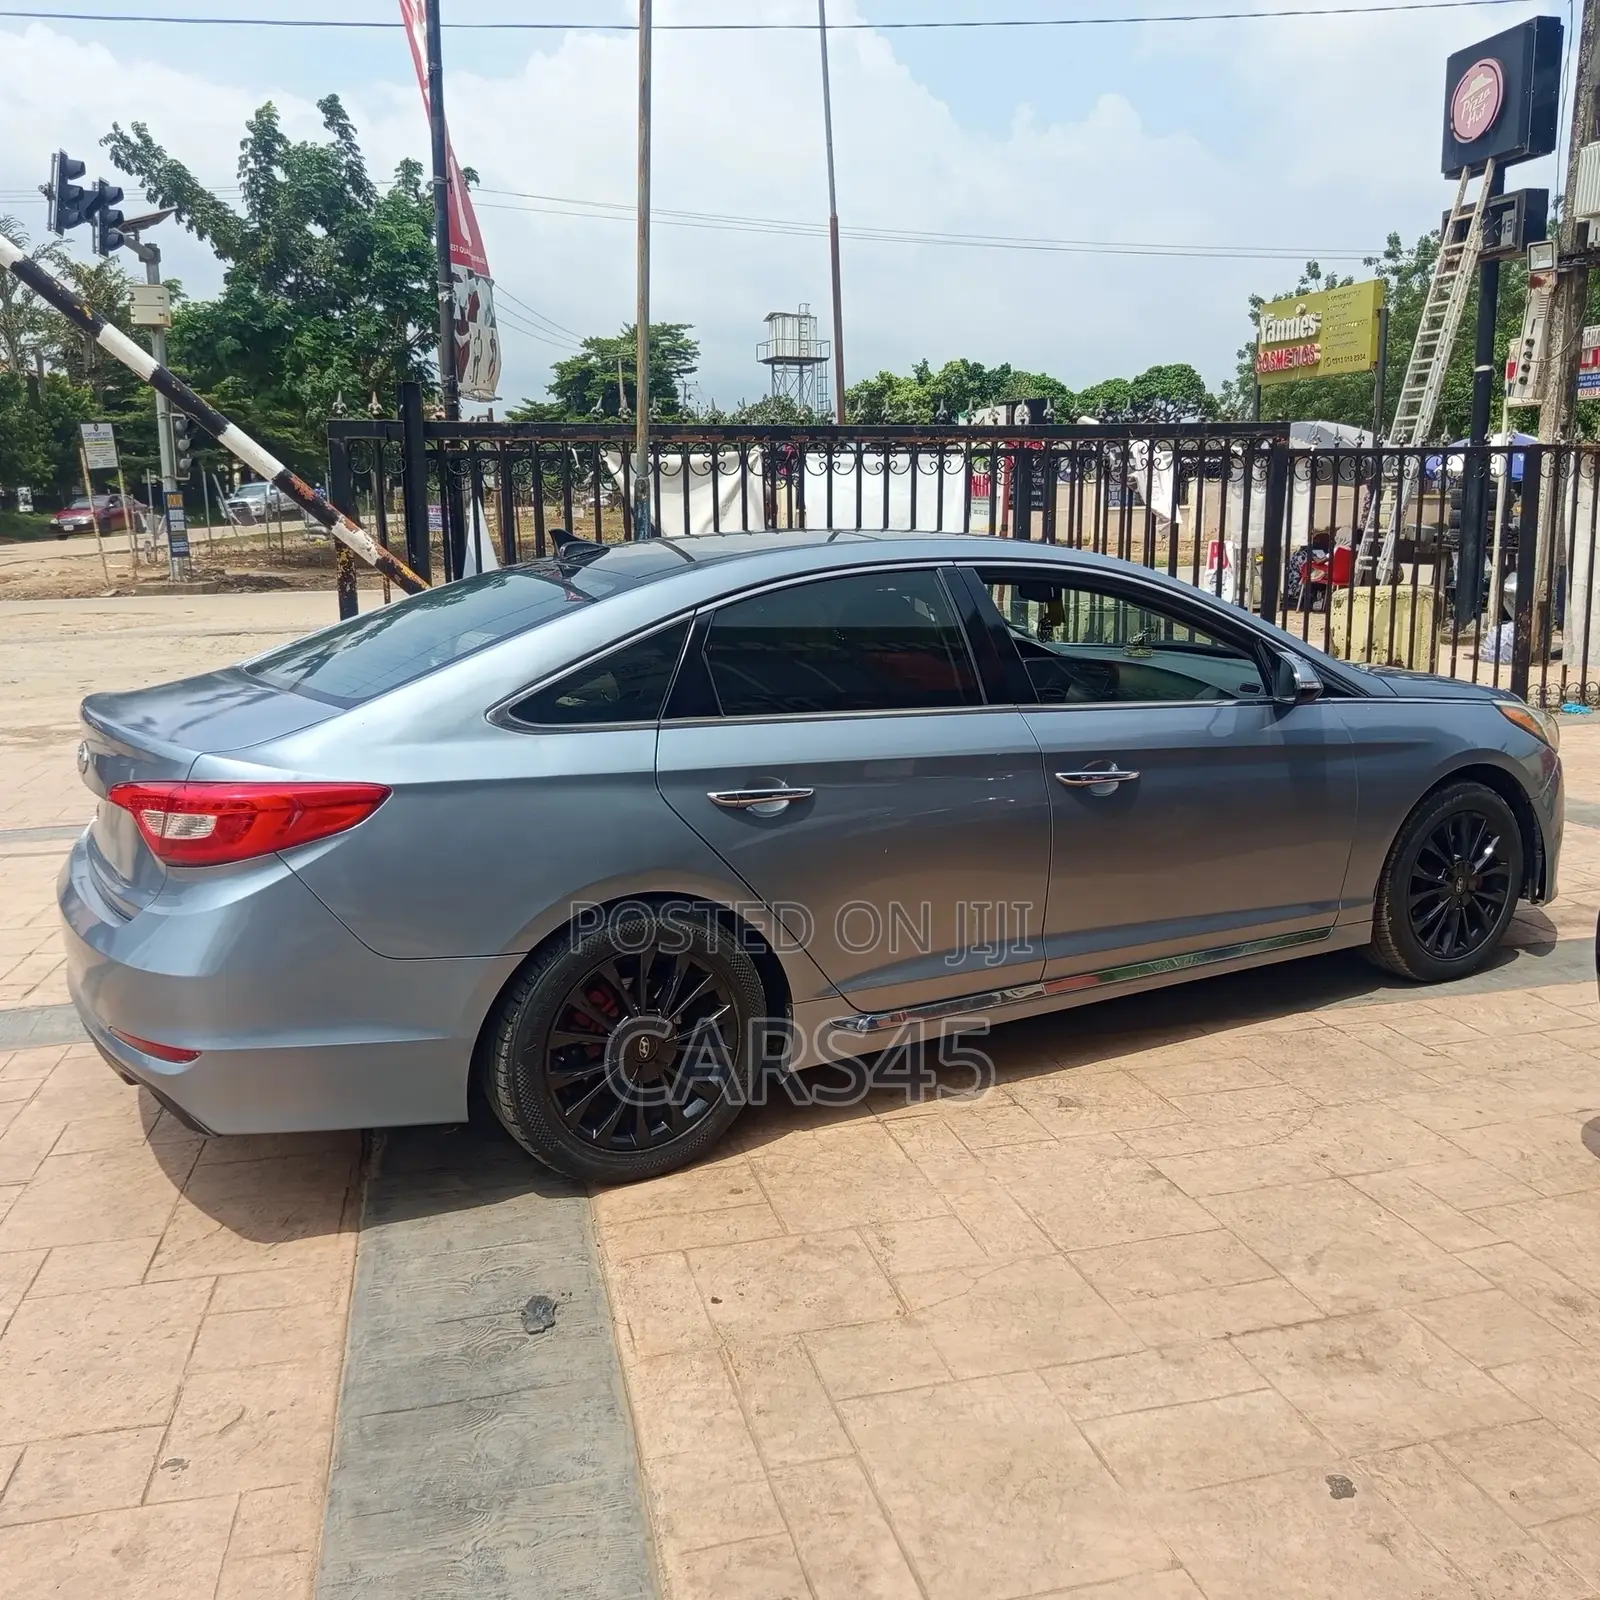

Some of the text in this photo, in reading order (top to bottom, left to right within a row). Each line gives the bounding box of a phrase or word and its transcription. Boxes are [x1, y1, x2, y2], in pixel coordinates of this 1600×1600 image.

[1461, 87, 1492, 121] Pizza
[1466, 102, 1488, 129] Hut
[1259, 303, 1321, 345] Yannies
[1255, 343, 1321, 374] COSMETICS
